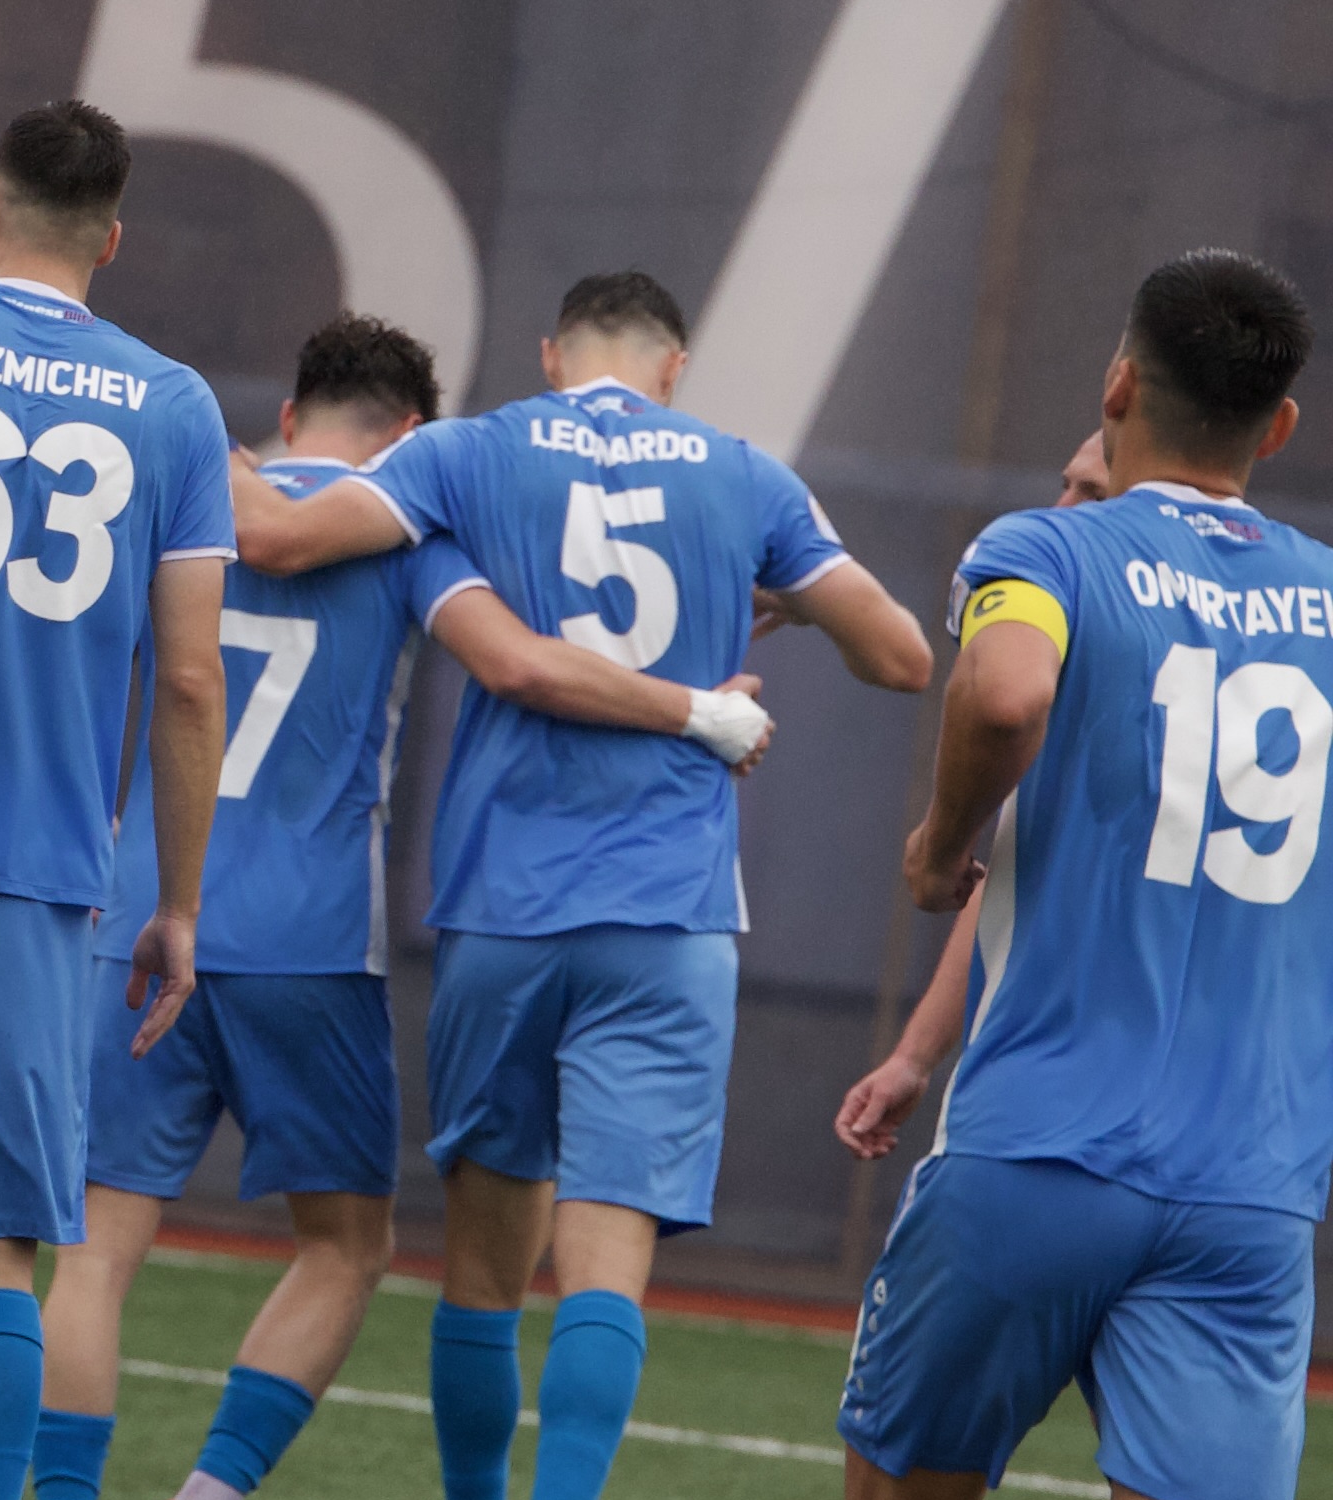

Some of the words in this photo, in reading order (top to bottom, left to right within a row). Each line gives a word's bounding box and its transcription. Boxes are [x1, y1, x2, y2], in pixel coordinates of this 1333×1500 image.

[559, 480, 679, 672] 5
[973, 589, 1006, 618] C
[218, 607, 318, 799] 7
[1144, 642, 1333, 905] 19
